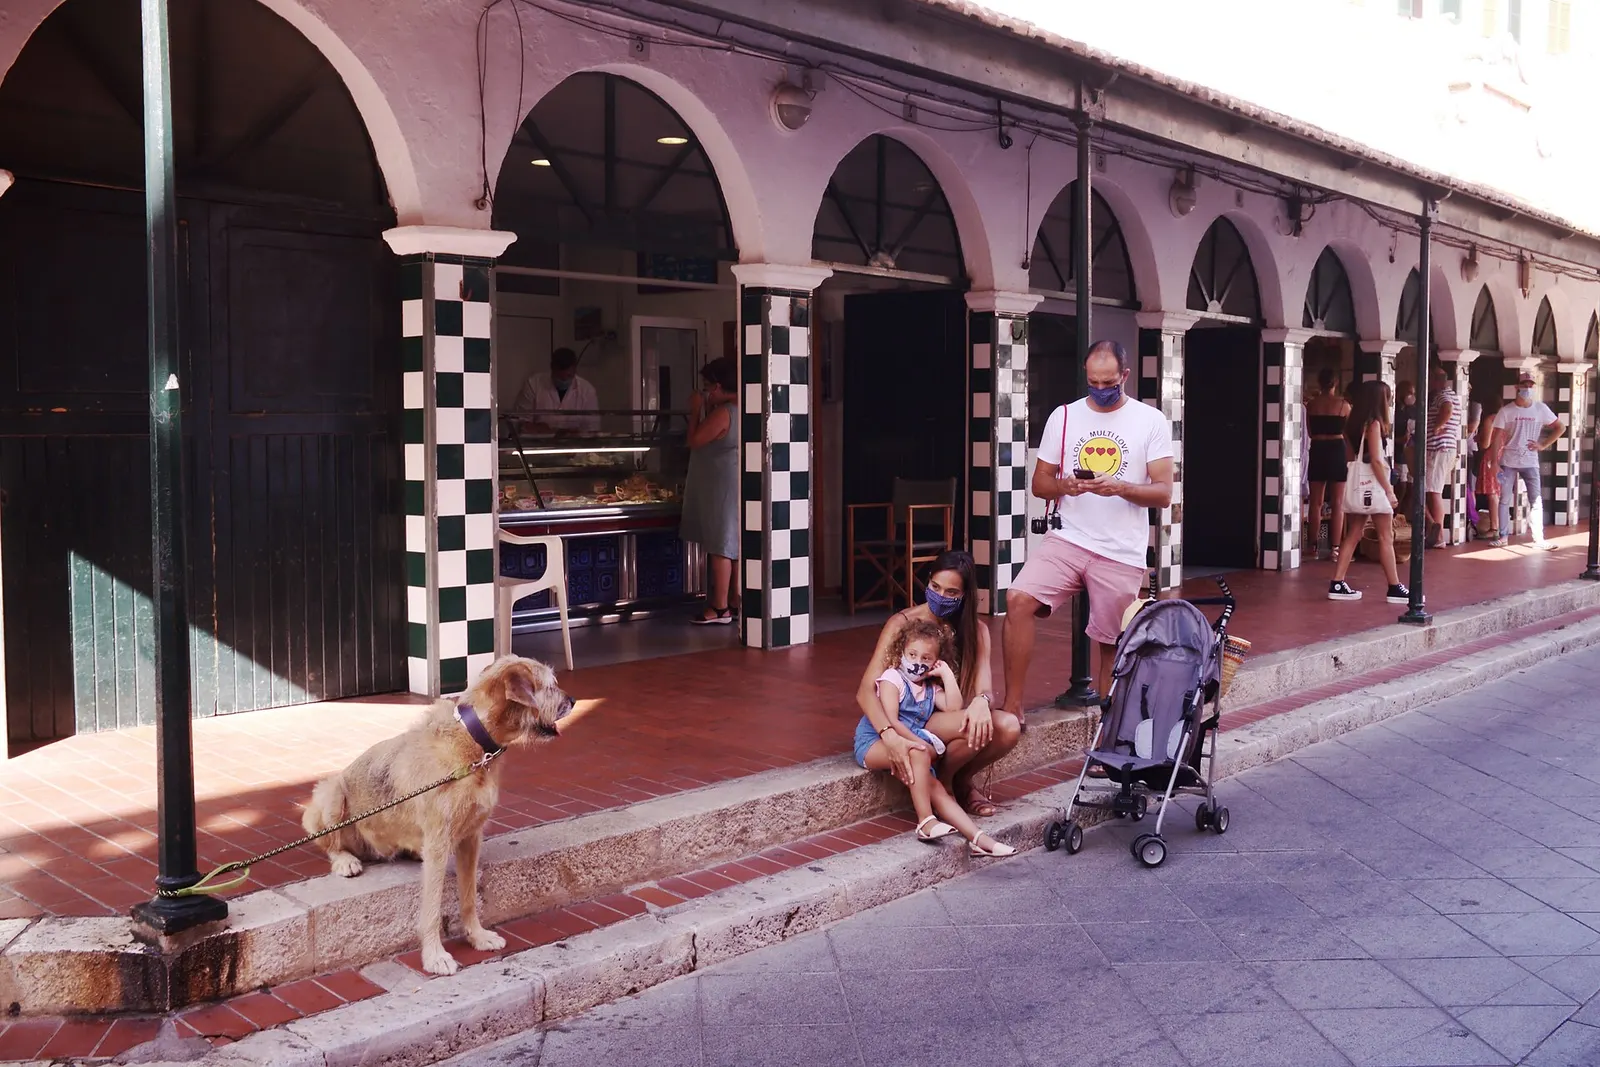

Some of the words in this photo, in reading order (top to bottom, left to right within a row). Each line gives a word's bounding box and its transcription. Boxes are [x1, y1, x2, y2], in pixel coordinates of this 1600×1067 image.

[1073, 437, 1086, 458] LOVE
[1115, 435, 1129, 455] LOVE
[1115, 461, 1128, 480] MULT
